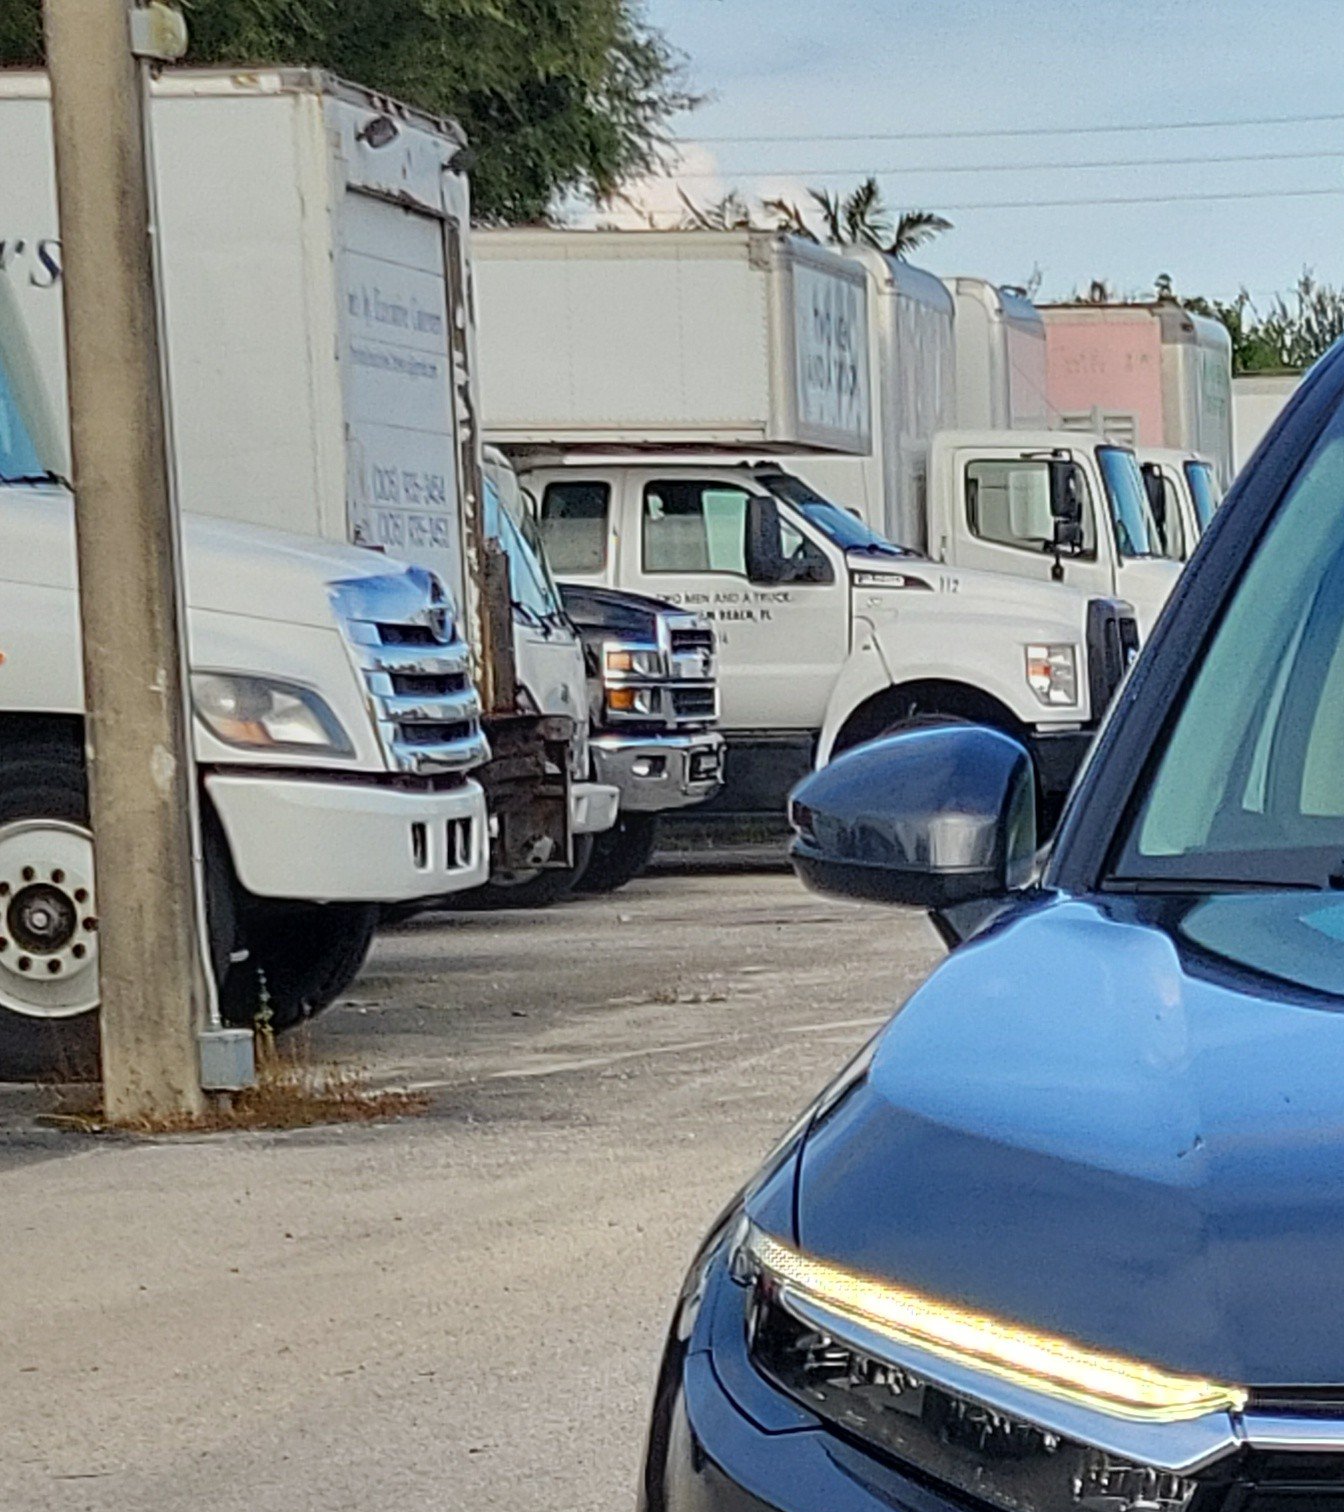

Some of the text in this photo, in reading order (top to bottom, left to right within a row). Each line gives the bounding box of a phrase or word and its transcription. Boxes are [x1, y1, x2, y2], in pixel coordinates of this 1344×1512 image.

[684, 591, 709, 603] MEN
[714, 591, 736, 604] AND
[743, 591, 752, 603] A
[754, 592, 790, 603] TRUCK
